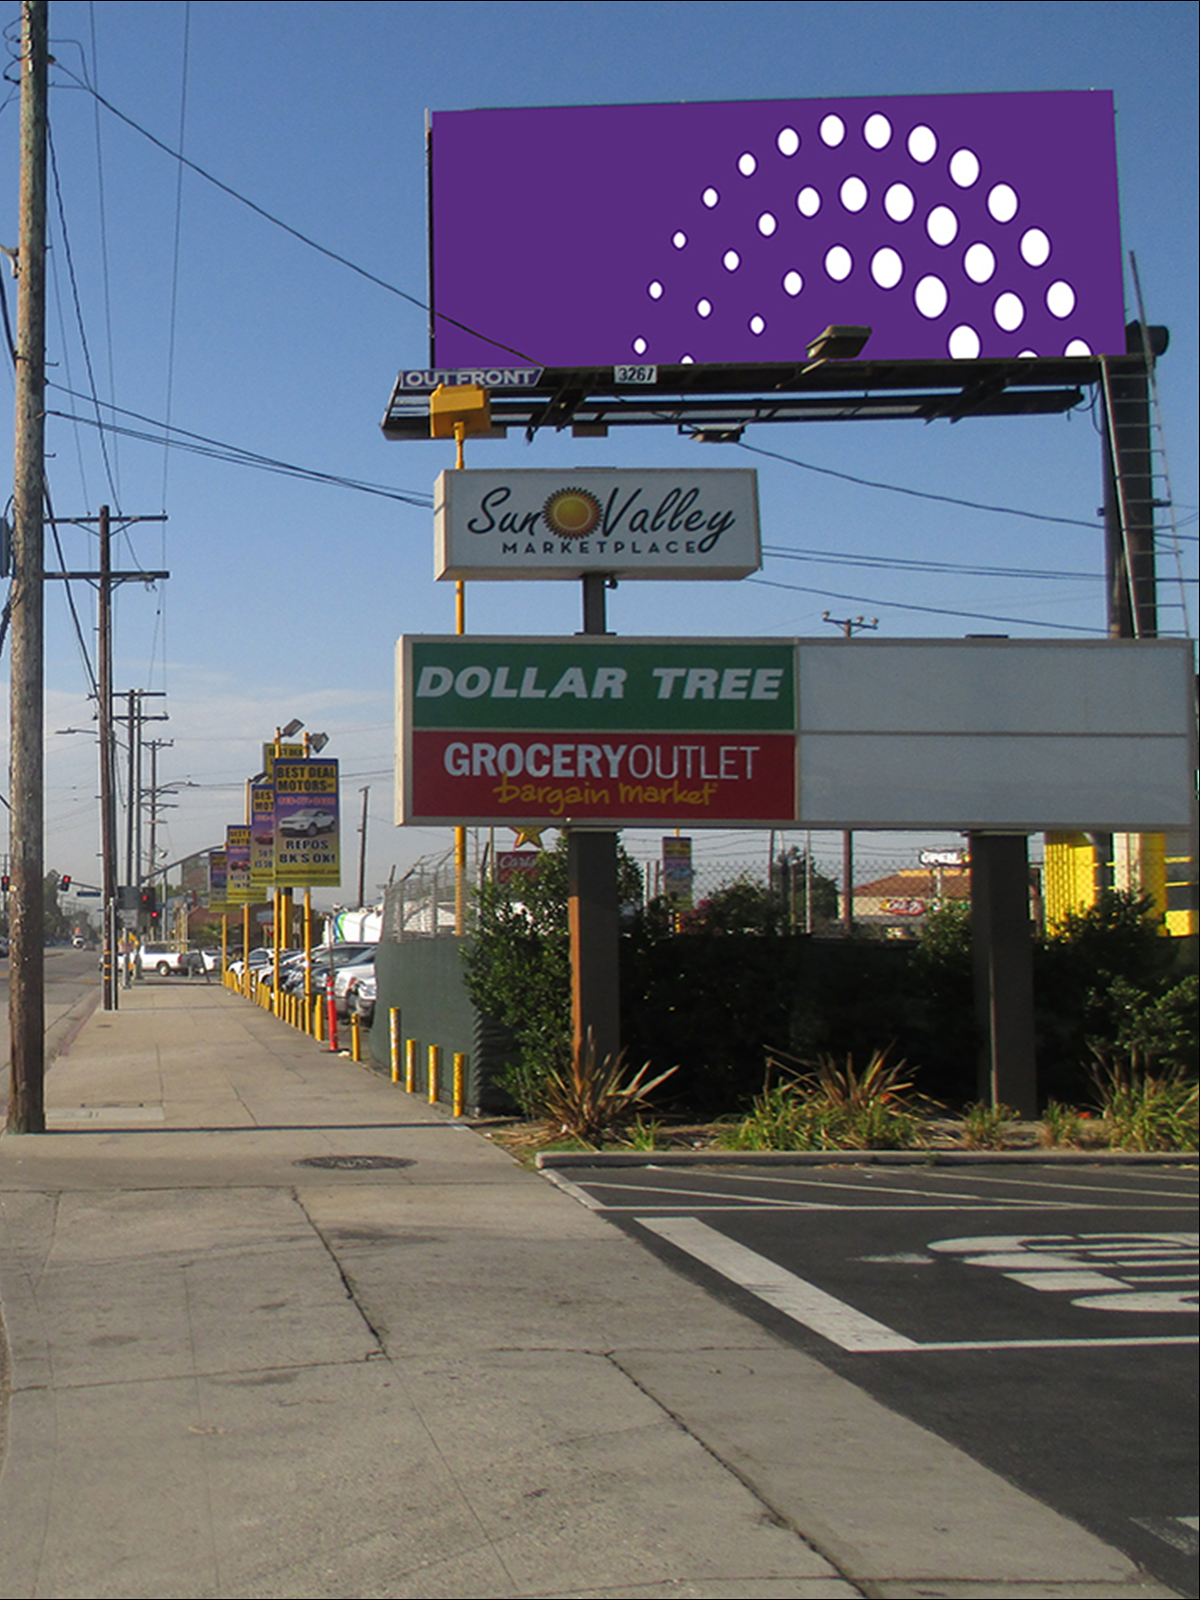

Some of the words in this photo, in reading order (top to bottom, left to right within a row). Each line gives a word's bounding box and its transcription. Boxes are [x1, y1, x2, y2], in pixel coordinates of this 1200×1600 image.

[467, 486, 543, 535] Sun
[601, 486, 735, 553] Valley
[502, 541, 698, 554] MARKETPLACE
[415, 666, 628, 699] DOLLAR
[652, 667, 784, 700] TREE
[277, 767, 306, 778] BEST
[308, 767, 336, 778] DEAL
[278, 780, 328, 791] MOTORS
[493, 770, 609, 815] bargain
[619, 781, 714, 805] market
[286, 840, 328, 850] REPOS
